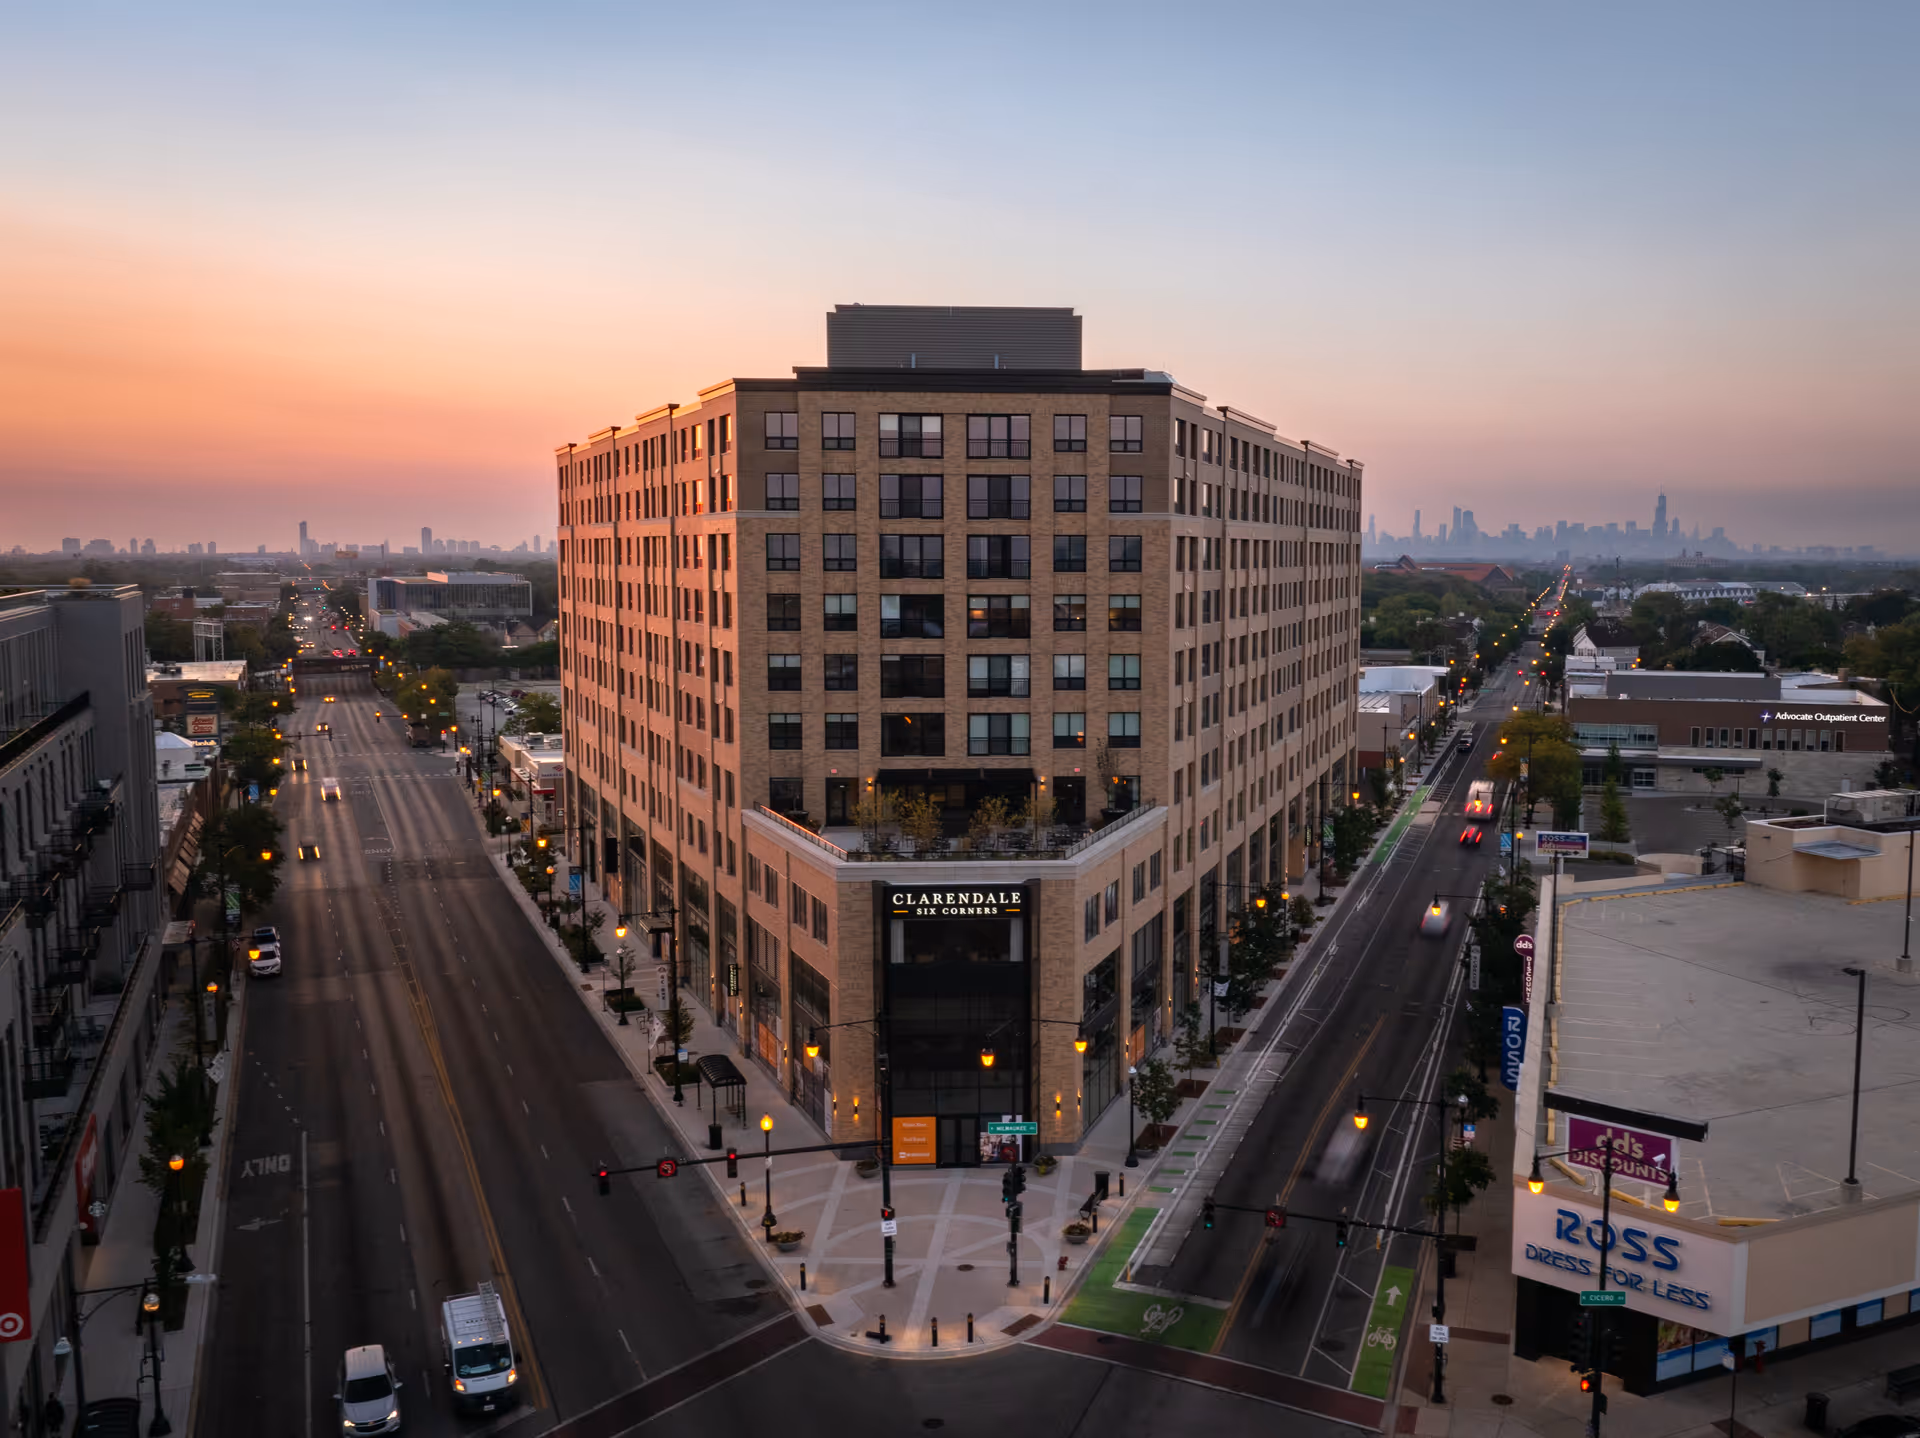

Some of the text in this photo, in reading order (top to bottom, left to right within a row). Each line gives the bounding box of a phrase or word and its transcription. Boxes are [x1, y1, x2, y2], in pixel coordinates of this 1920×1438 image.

[1775, 712, 1886, 723] Advocate Outpatient Center
[892, 892, 1020, 904] CLARENDALE
[1506, 1016, 1522, 1083] ROSS
[1596, 1128, 1644, 1159] dd's
[241, 1154, 290, 1178] ONLY
[1572, 1148, 1668, 1182] DISCOUNTS
[1556, 1208, 1681, 1271] ROSS
[1526, 1242, 1710, 1310] DRESS FOR LESS
